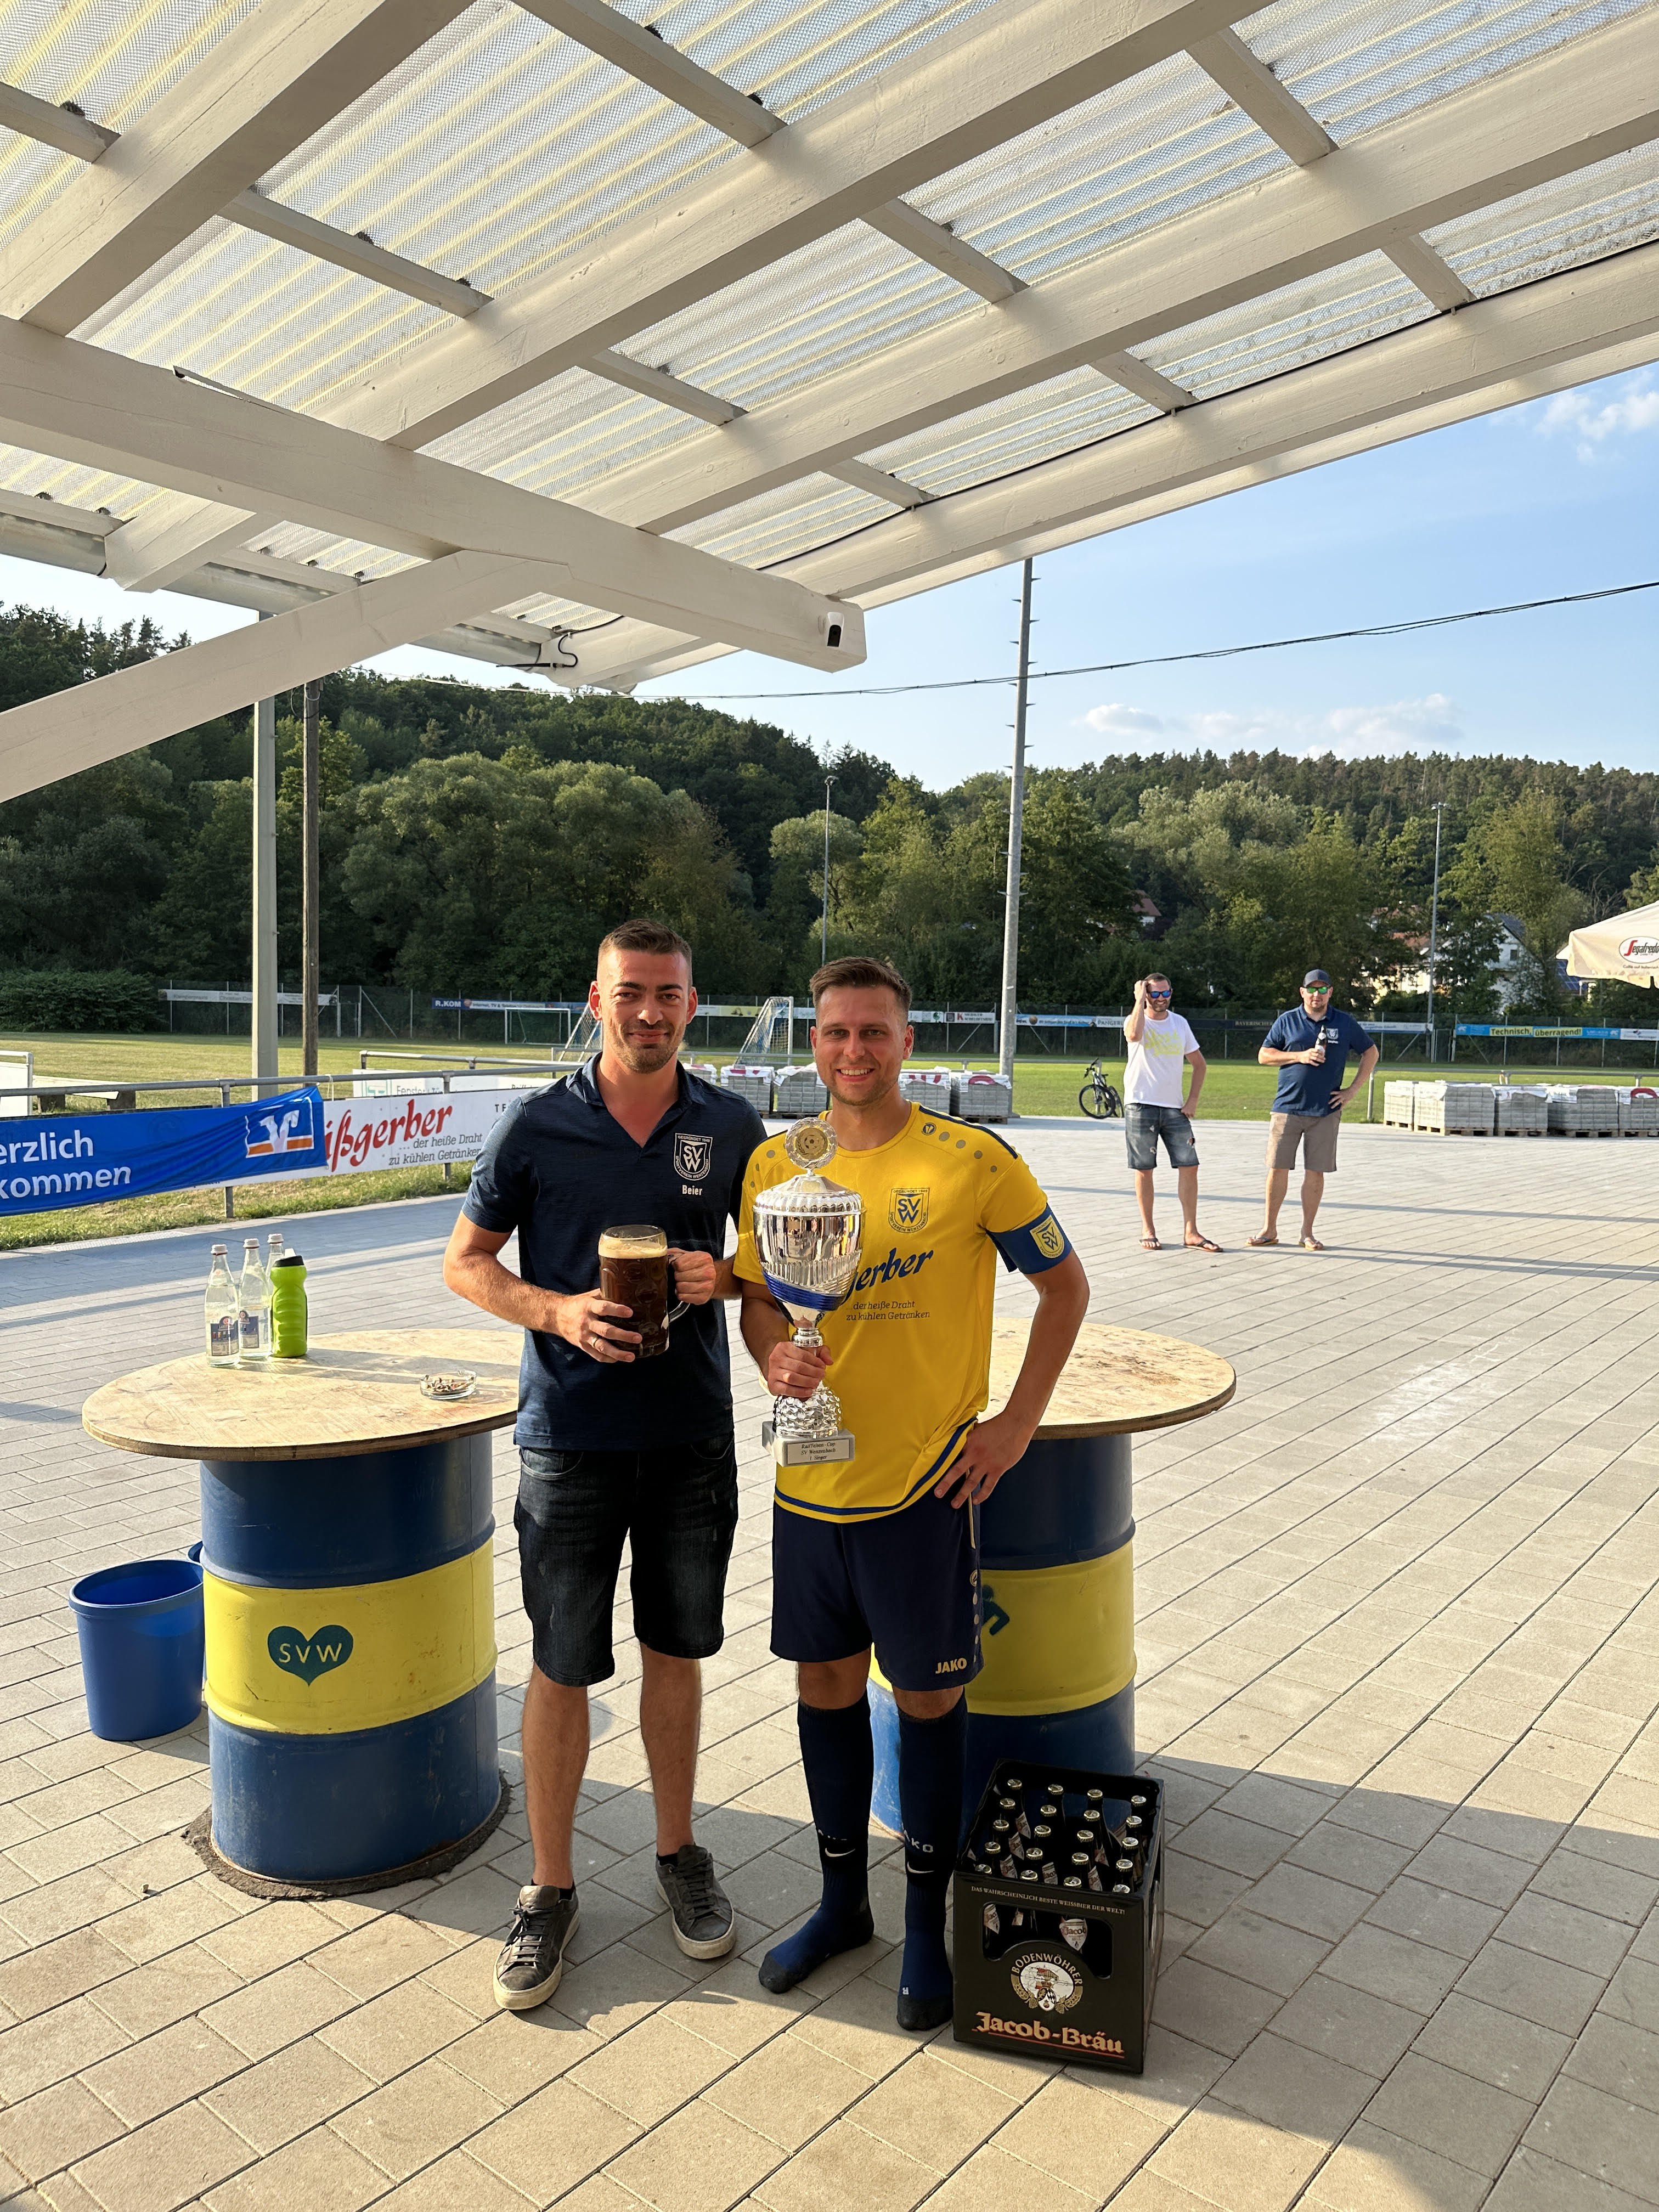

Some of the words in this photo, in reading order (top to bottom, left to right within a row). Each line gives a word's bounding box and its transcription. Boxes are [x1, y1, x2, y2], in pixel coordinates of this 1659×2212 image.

[413, 1137, 428, 1149] der
[432, 1135, 456, 1148] heiße
[459, 1133, 483, 1146] Draht
[388, 1156, 400, 1166] zu
[403, 1153, 435, 1164] kühlen
[682, 1184, 703, 1195] Beier
[868, 1301, 890, 1311] heiße
[891, 1300, 915, 1309] Draht
[858, 1312, 886, 1321] kühlen
[888, 1311, 930, 1319] Getränken
[935, 1657, 967, 1674] JAKO
[984, 1888, 1038, 1901] WAHRSCHEINLICH
[1059, 1899, 1091, 1910] WEISSBIER
[1011, 1953, 1083, 1984] BODENWÖHRER
[976, 2011, 1125, 2053] Jacob-Bräu
